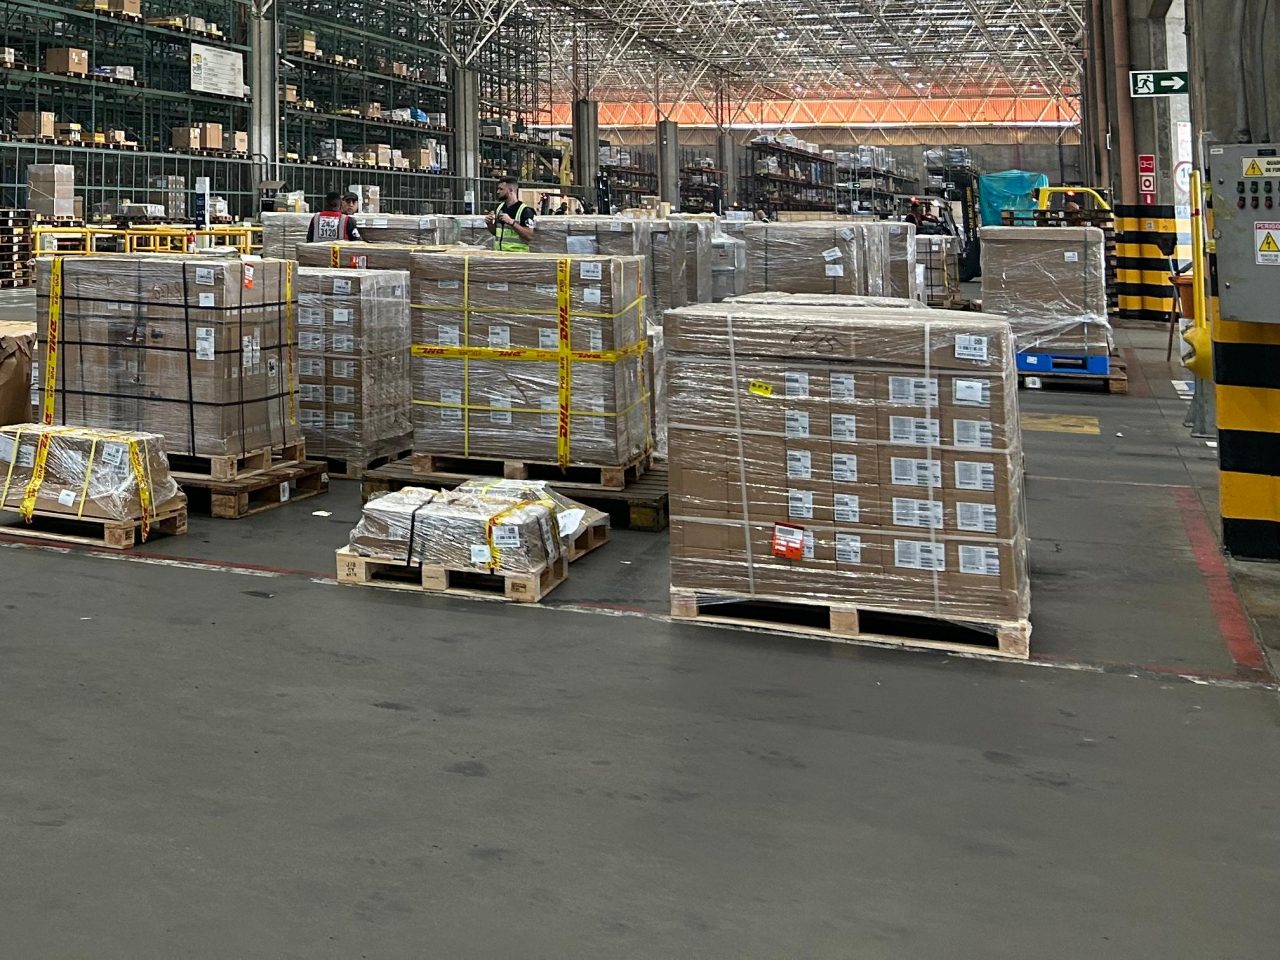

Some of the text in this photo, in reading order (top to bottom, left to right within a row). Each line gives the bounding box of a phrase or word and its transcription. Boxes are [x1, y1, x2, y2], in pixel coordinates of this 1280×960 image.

[48, 319, 58, 354] DHL
[559, 305, 568, 341] DHL
[559, 403, 568, 438] DHL
